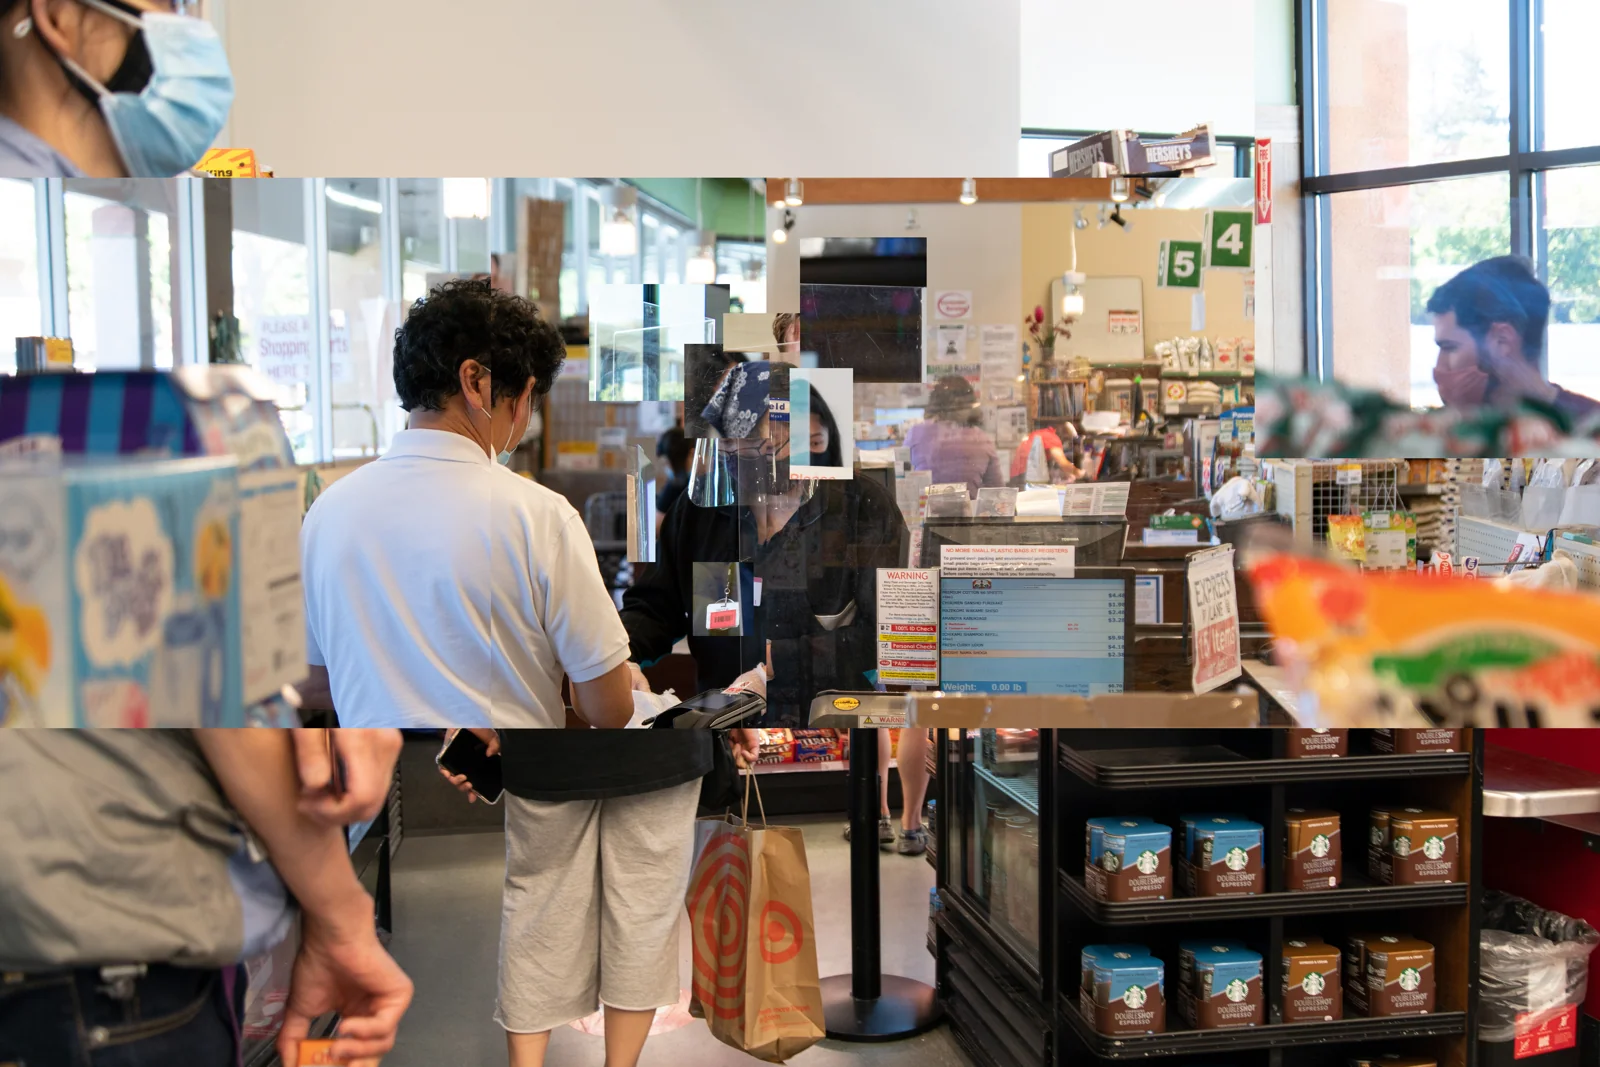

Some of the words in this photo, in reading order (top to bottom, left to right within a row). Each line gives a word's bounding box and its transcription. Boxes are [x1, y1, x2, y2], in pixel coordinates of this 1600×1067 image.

[1068, 142, 1105, 174] HERSHEY'S
[1146, 144, 1192, 163] HERSHEY'S
[1216, 223, 1244, 255] 4
[1173, 251, 1195, 278] 5
[887, 572, 928, 580] WARNING
[1194, 570, 1231, 607] EXPRESS
[1210, 602, 1223, 621] LANE
[1198, 632, 1209, 659] 15
[1212, 626, 1235, 654] Items
[943, 683, 976, 692] Weight:
[1303, 859, 1336, 869] DOUBLESHOT
[1415, 862, 1452, 870] DOUBLESHOT
[1129, 877, 1166, 886] DOUBLESHOT
[1217, 874, 1256, 882] DOUBLESHOT
[1391, 993, 1428, 1002] DOUBLESHOT
[1294, 998, 1333, 1007] DOUBLESHOT
[1218, 1004, 1256, 1013] DOUBLESHOT
[1115, 1012, 1155, 1020] DOUBLESHOT
